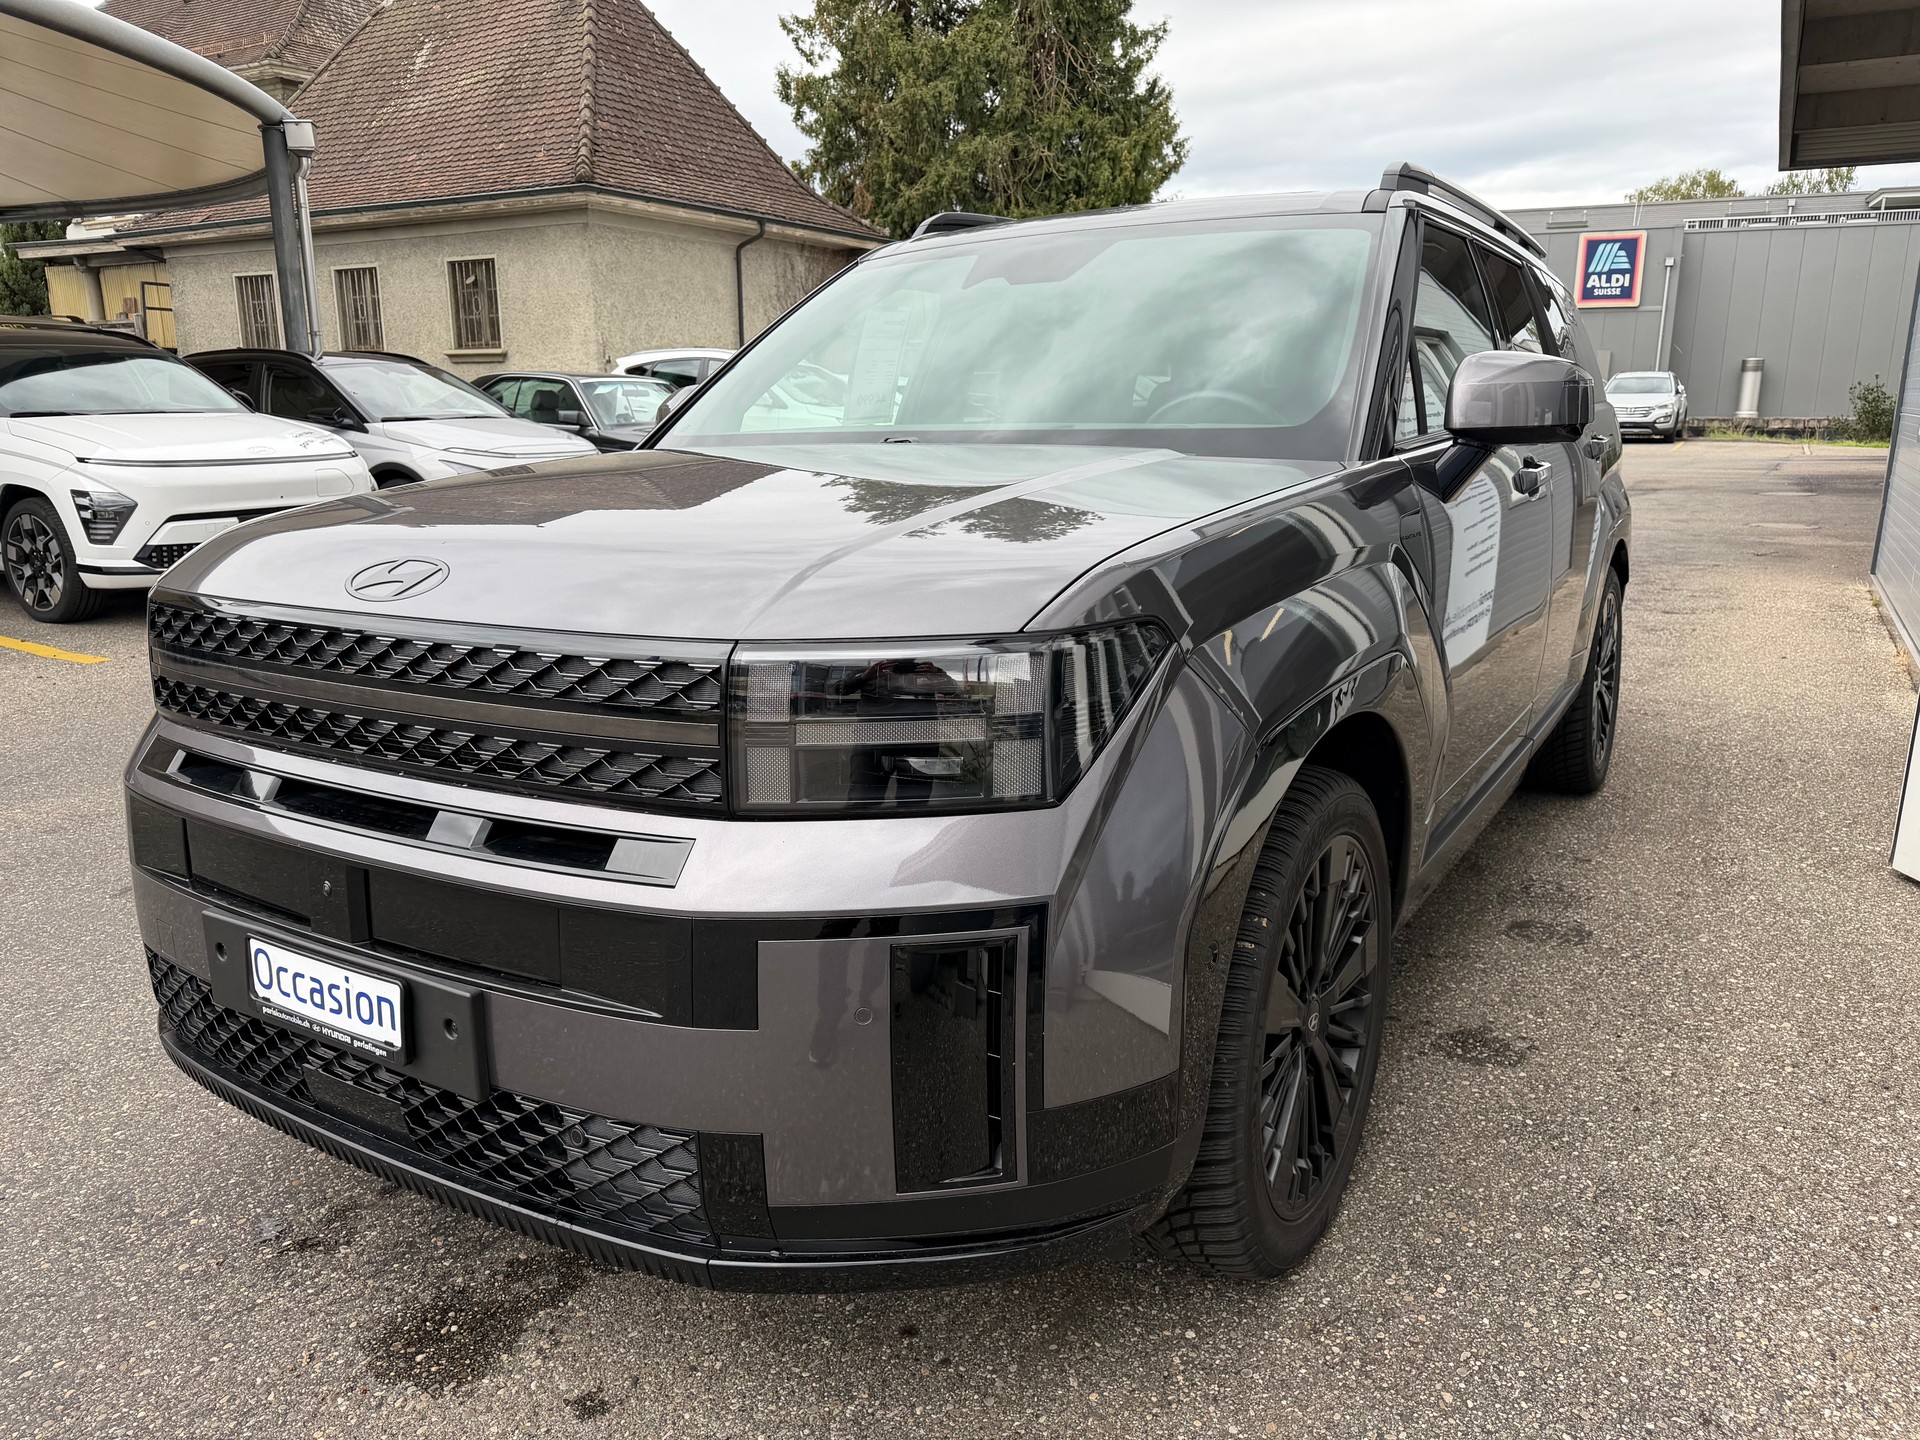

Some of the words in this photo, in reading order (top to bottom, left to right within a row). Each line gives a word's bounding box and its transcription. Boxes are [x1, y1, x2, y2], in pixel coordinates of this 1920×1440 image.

[1586, 273, 1630, 288] ALDI
[1593, 287, 1622, 296] SUISSE
[254, 948, 396, 1031] Occasion
[322, 1026, 352, 1044] HYUNDAI
[353, 1039, 387, 1057] gerlafingen
